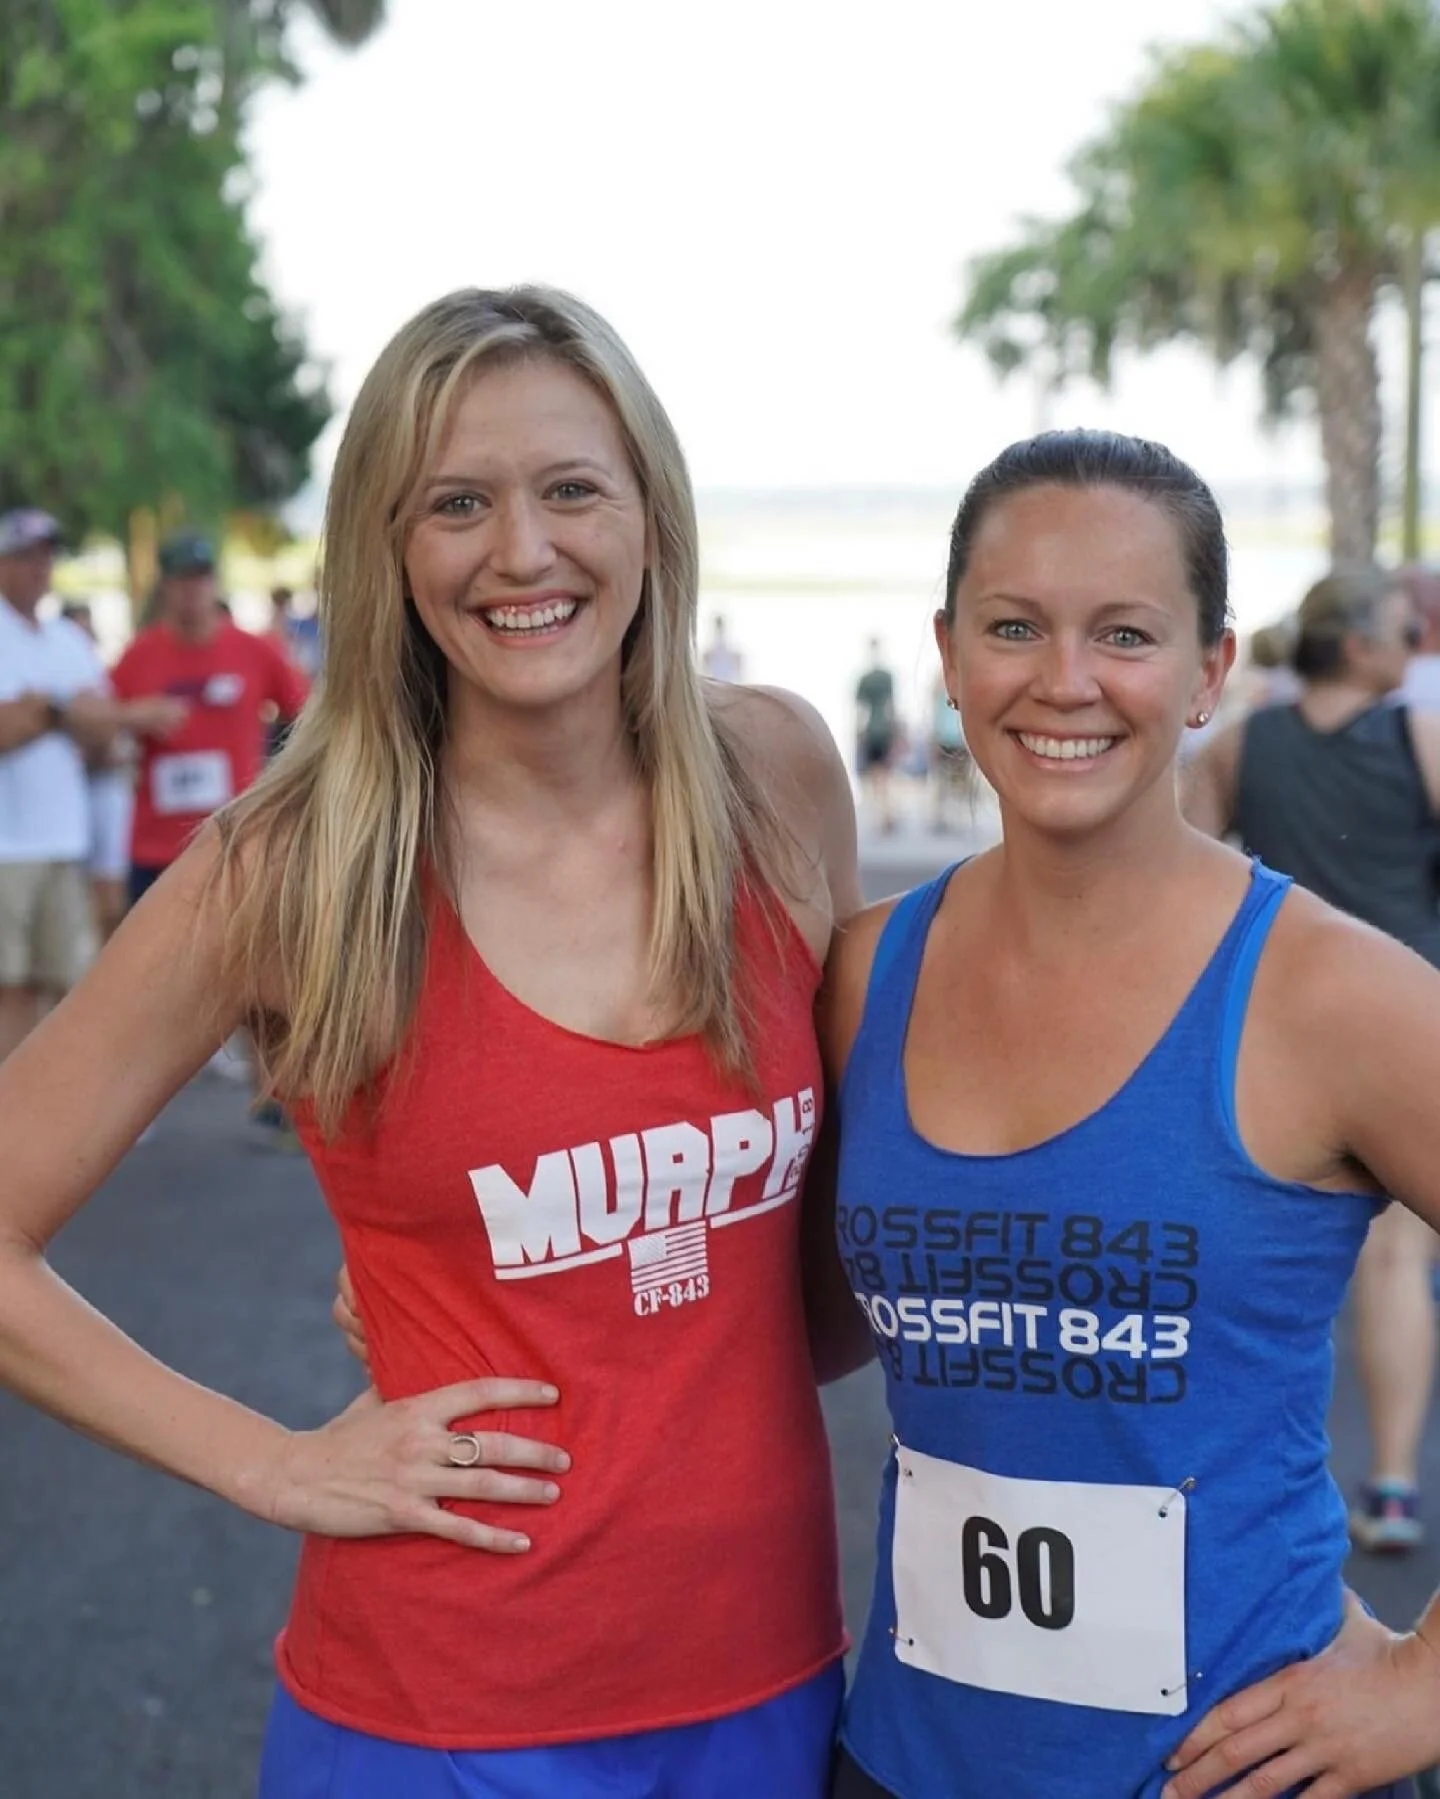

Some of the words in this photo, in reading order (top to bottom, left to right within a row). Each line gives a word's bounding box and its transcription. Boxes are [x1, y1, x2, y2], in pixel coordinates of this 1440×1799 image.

[468, 1087, 814, 1266] MURPH
[838, 1206, 1050, 1256] ROSSFIT
[1061, 1214, 1200, 1270] 843
[633, 1274, 710, 1316] CF-843
[897, 1252, 1198, 1310] CROSSFIT
[855, 1292, 1048, 1350] ROSSFIT
[1058, 1307, 1191, 1360] 843
[914, 1344, 1186, 1404] CROSSFIT
[961, 1515, 1076, 1631] 60
